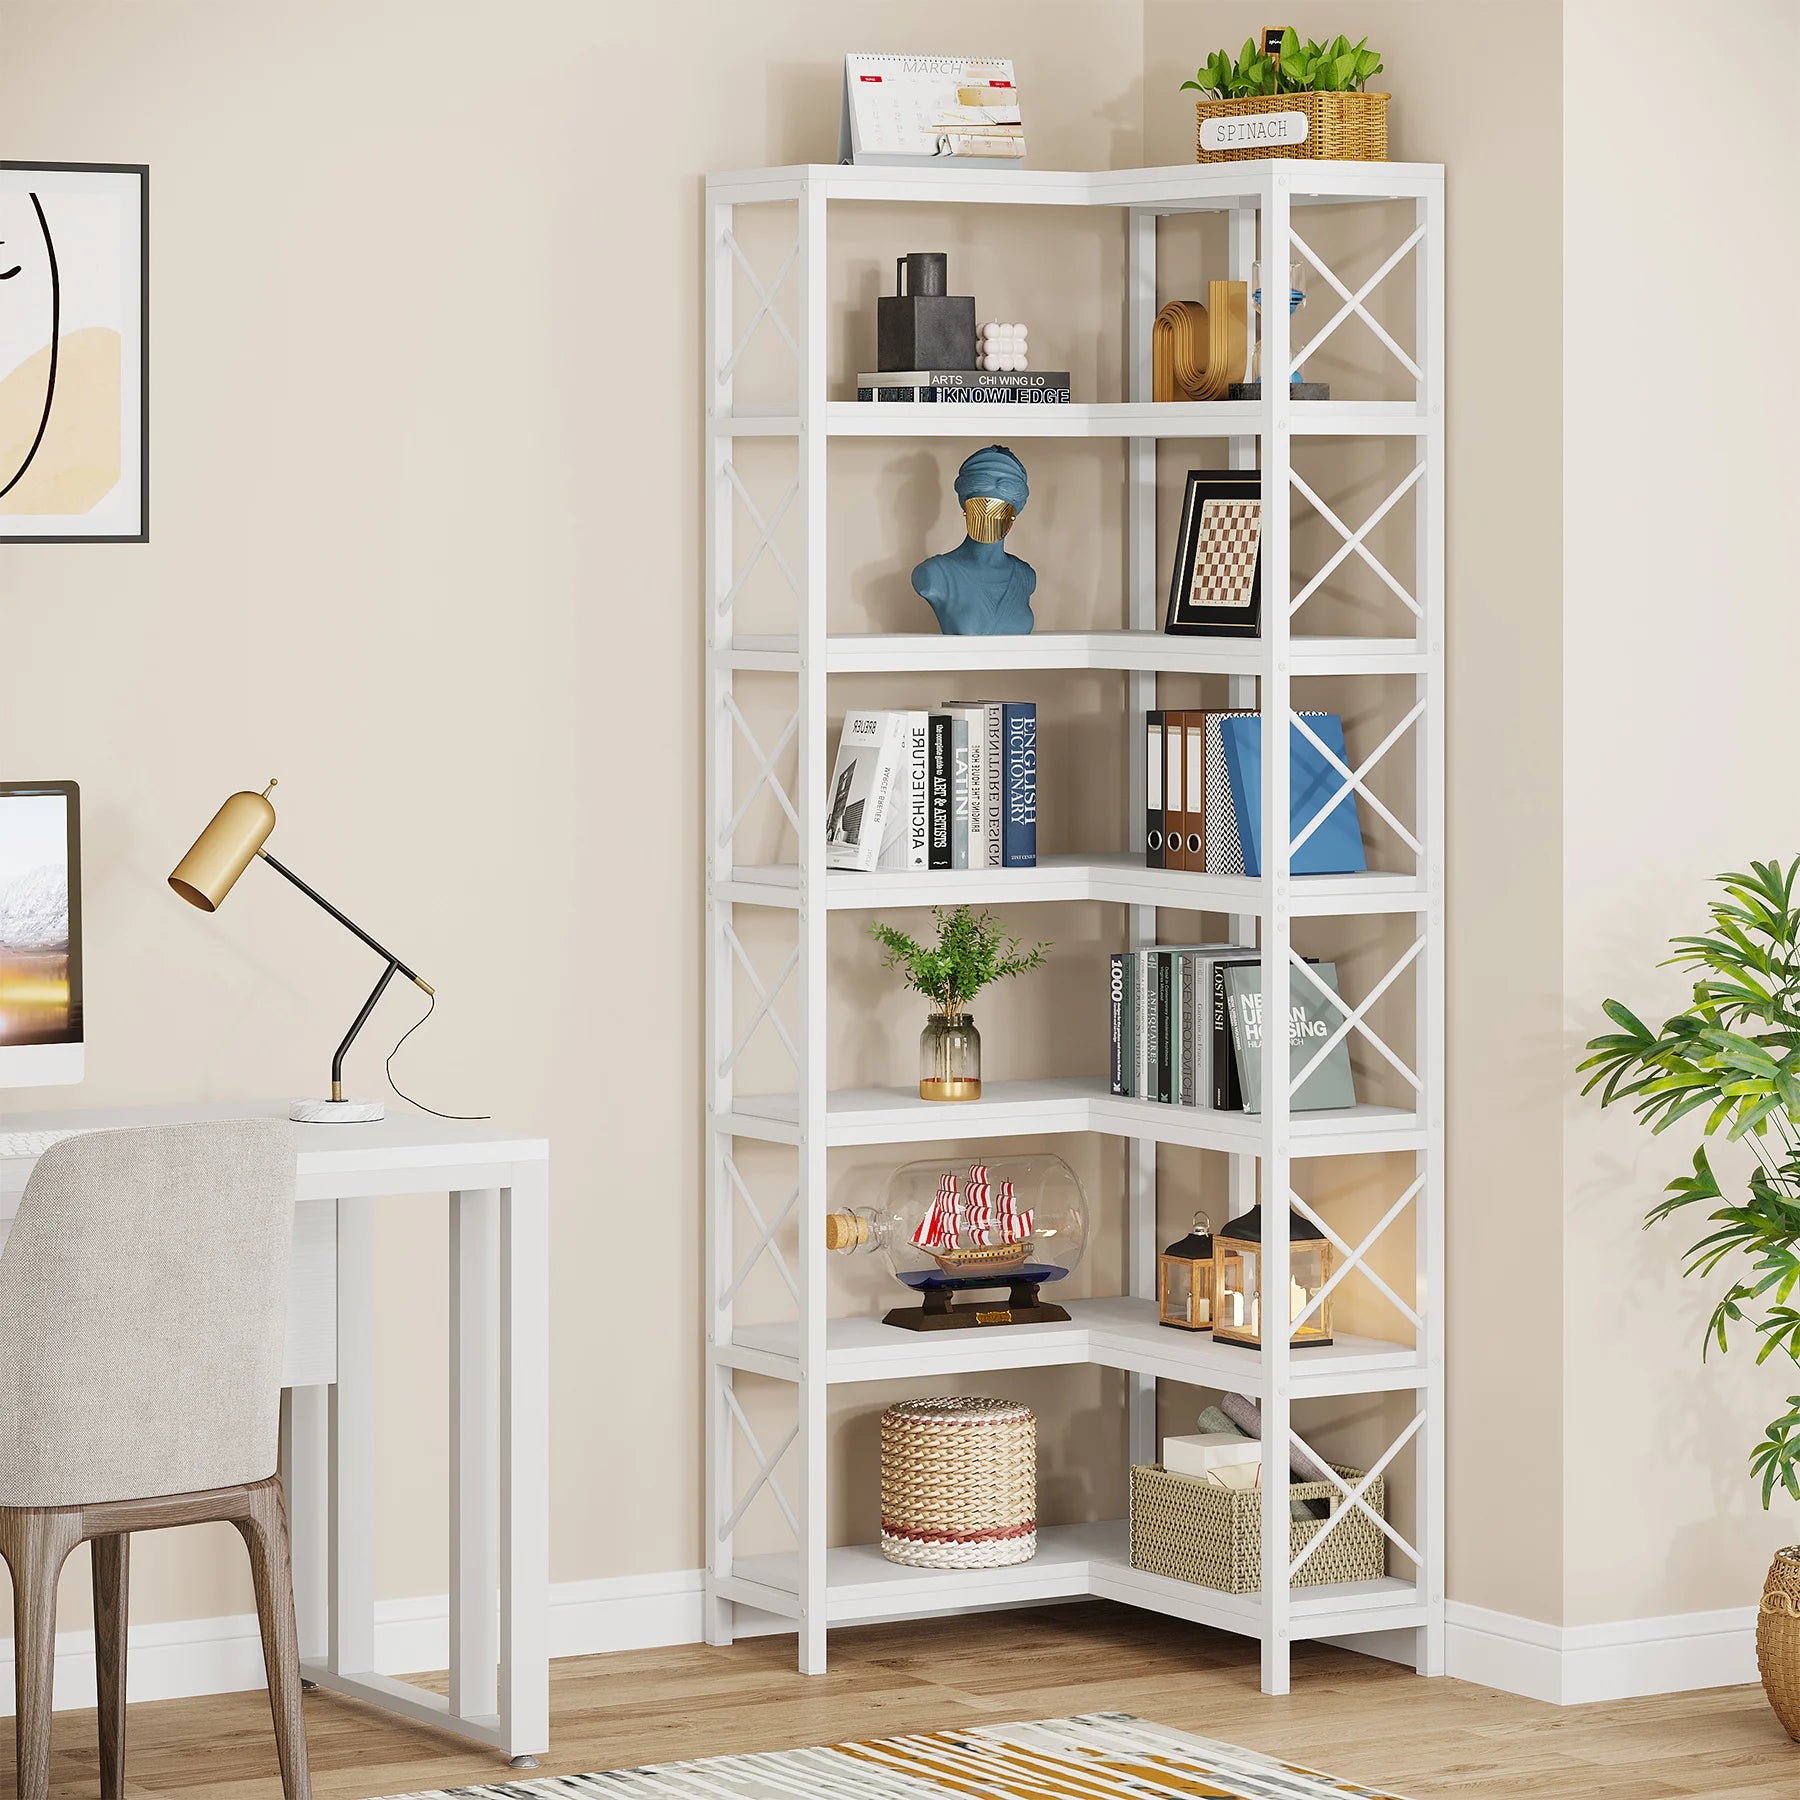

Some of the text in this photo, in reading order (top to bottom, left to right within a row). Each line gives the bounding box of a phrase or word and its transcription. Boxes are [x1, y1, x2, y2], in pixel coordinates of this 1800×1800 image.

[902, 61, 962, 75] MARCH
[1216, 120, 1288, 142] SPINACH
[932, 376, 1045, 386] ARTS CHI WING LO
[944, 387, 1069, 403] KNOWLEDGE
[1011, 717, 1024, 826] DICTIONARY
[1023, 717, 1036, 825] ENGLISH
[934, 776, 947, 796] ART
[934, 798, 946, 806] &
[934, 808, 947, 848] ARTISTS
[1111, 960, 1123, 1002] 1000
[1214, 966, 1223, 1031] LOST FISH
[1241, 993, 1262, 1009] NE
[1183, 957, 1192, 1097] ALEXEY BRODOVITCH
